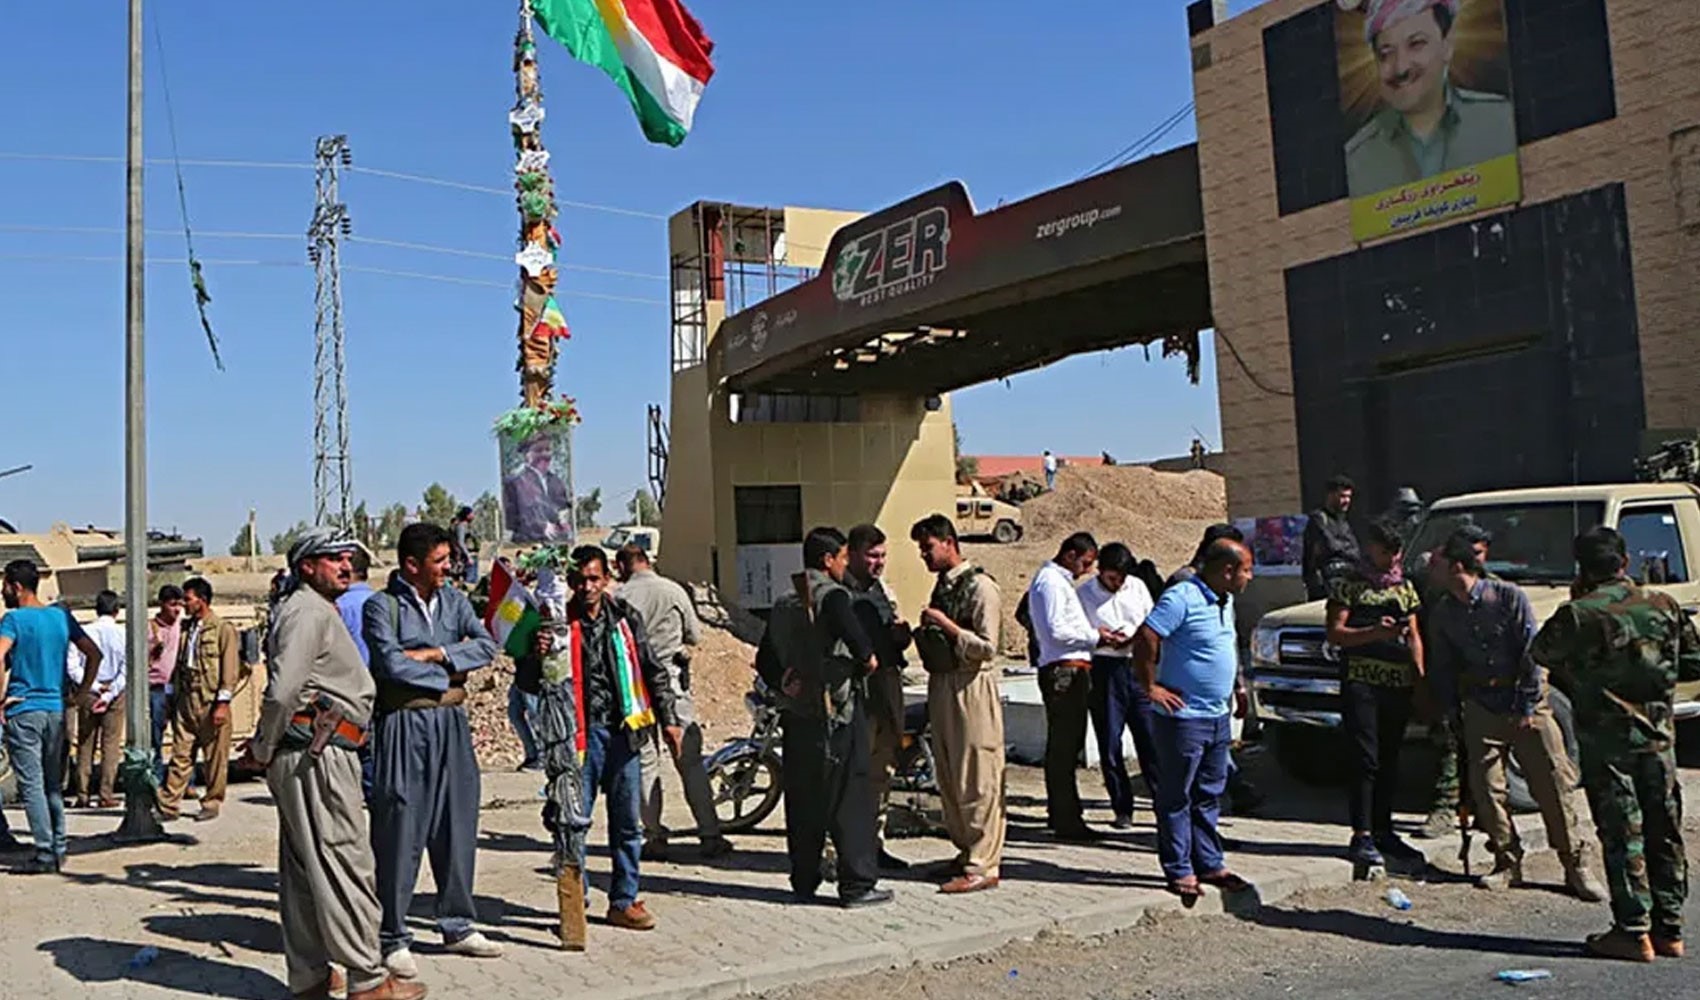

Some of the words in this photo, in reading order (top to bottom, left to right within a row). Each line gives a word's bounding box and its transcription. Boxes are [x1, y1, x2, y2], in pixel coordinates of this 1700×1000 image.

[851, 206, 949, 299] ZER
[861, 286, 886, 306] BEST
[888, 274, 935, 298] QUALITY
